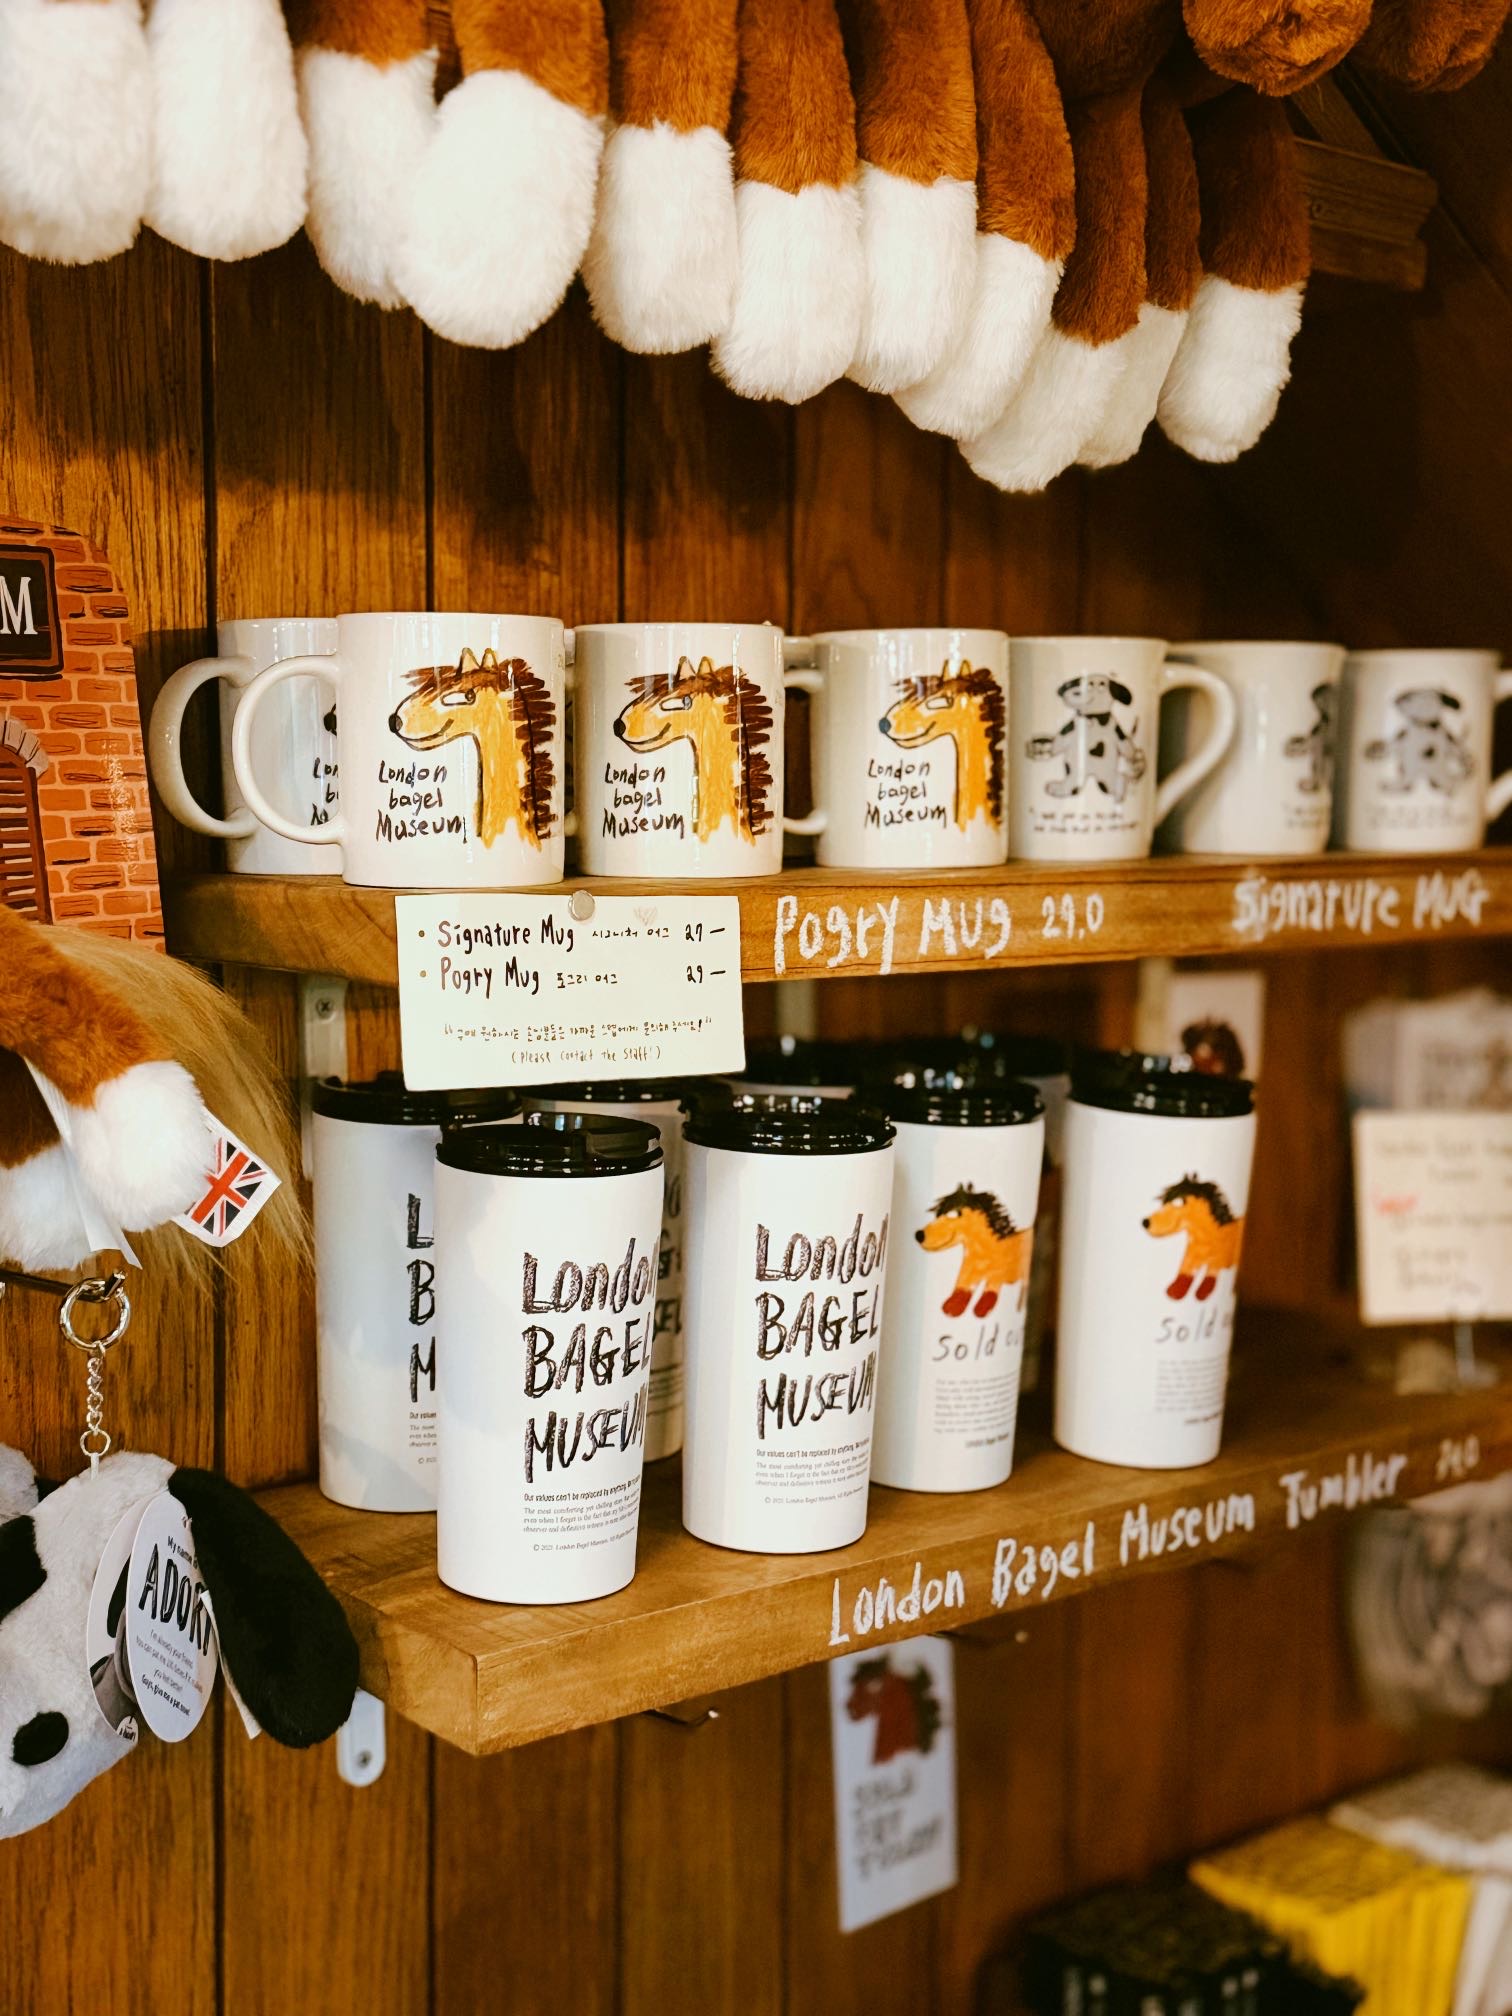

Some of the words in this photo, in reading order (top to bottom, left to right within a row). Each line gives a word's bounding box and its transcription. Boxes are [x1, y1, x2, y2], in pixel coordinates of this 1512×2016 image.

[378, 760, 448, 788] London
[604, 762, 666, 789] London
[867, 758, 930, 781] London
[388, 789, 443, 816] bagel
[613, 790, 662, 814] bagel
[877, 782, 928, 806] bagel
[375, 808, 468, 844] Museum
[602, 808, 685, 840] Museum
[865, 802, 948, 829] Museum
[437, 920, 531, 954] Signature
[541, 914, 574, 952] Mug
[774, 895, 900, 976] Pogry
[440, 956, 492, 999] Pogry
[505, 955, 539, 996] Mug
[755, 1283, 880, 1361] BAGEL
[1154, 1307, 1218, 1344] Sold
[521, 1311, 652, 1399] BAGEL
[932, 1323, 999, 1362] Sold
[828, 1561, 966, 1648] London
[991, 1520, 1095, 1609] Bagel
[1119, 1493, 1255, 1567] Museum
[1279, 1451, 1408, 1530] Tumbler
